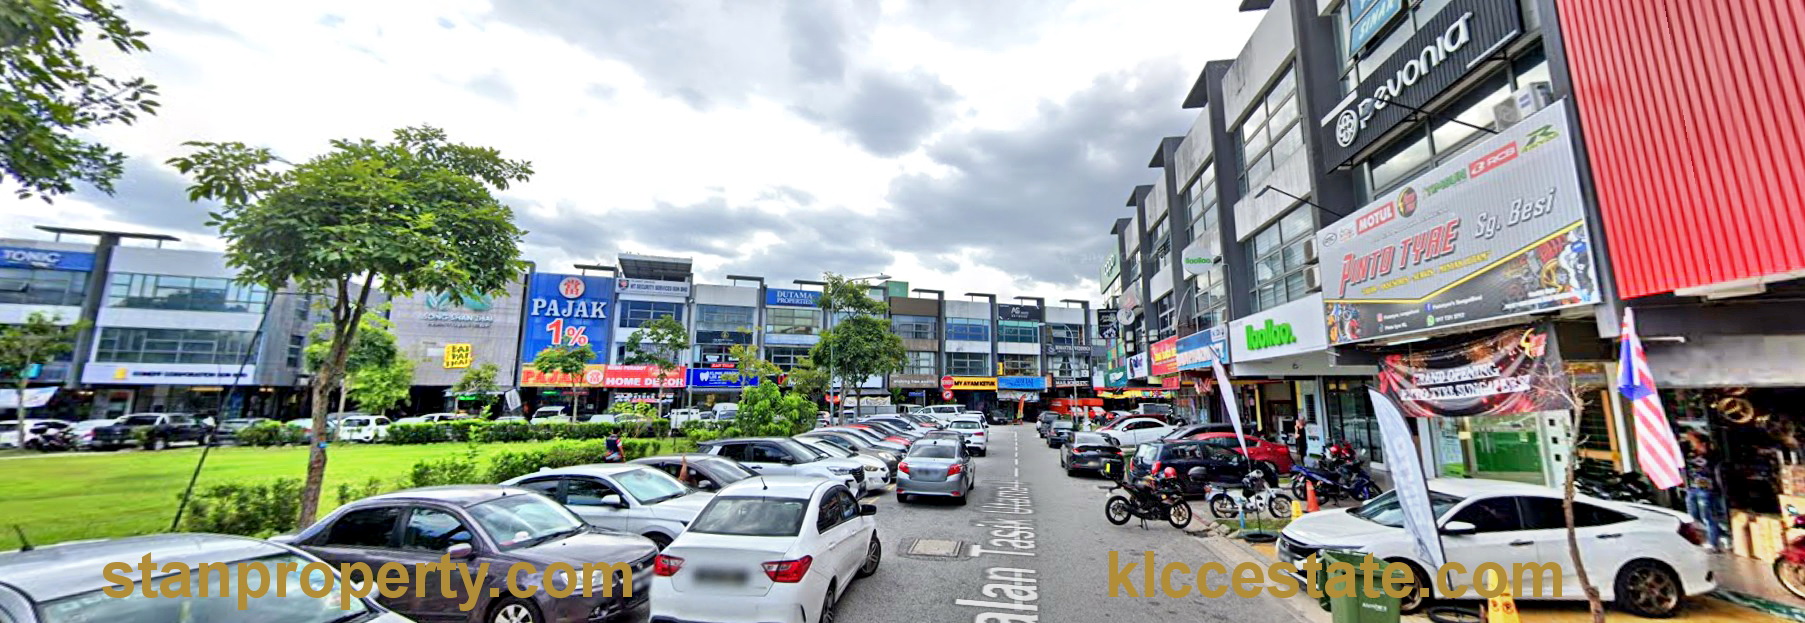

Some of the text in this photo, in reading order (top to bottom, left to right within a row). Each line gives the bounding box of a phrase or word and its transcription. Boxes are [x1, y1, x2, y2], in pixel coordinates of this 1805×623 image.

[1358, 12, 1473, 129] pevonia
[1359, 206, 1393, 231] MOTUL
[1339, 245, 1396, 298] PINTO
[1400, 217, 1461, 270] TYRE
[1475, 212, 1502, 239] Sg.
[1507, 187, 1557, 227] Besi
[776, 291, 812, 299] DUTAMA
[531, 298, 607, 319] PAJAK
[546, 317, 588, 346] 1%
[605, 377, 641, 386] HOME
